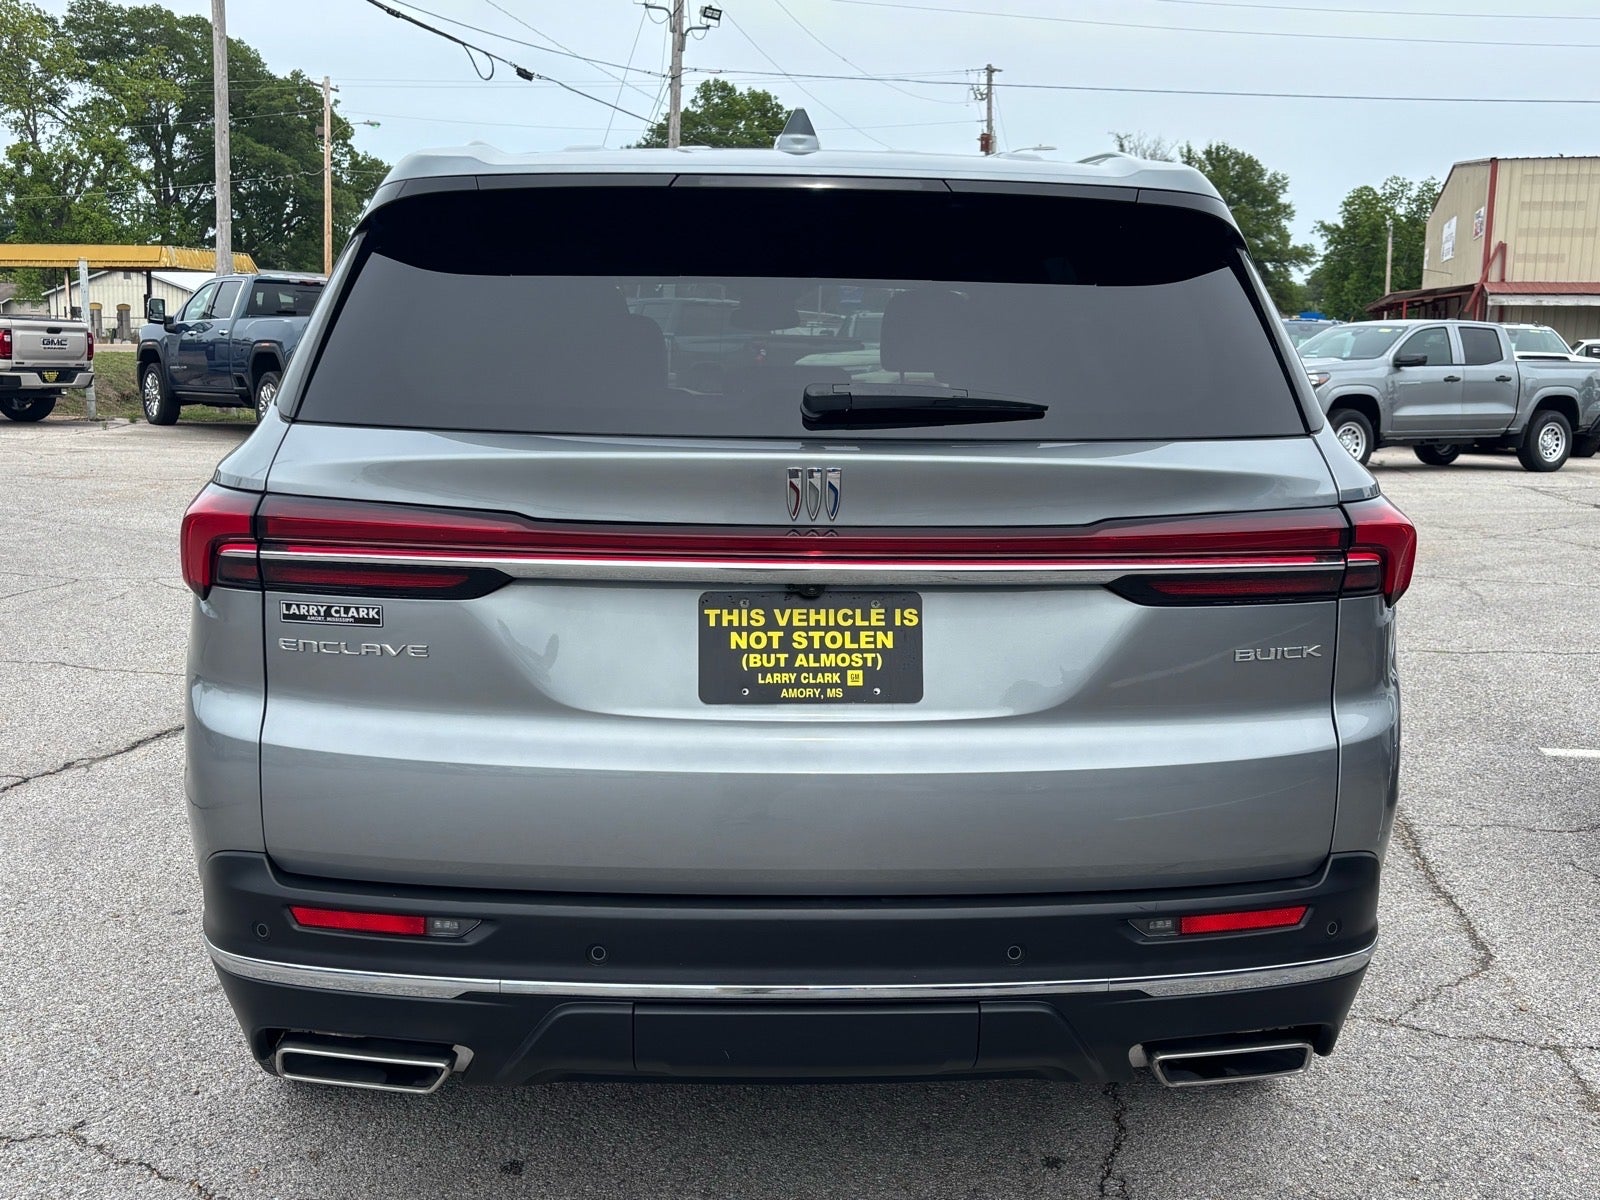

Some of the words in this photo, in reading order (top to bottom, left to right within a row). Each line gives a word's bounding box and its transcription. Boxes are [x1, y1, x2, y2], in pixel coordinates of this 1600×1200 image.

[42, 338, 68, 346] GMC
[282, 604, 327, 616] LARRY
[331, 607, 380, 618] CLARK
[704, 608, 766, 627] THIS
[773, 608, 886, 627] VEHICLE
[894, 608, 919, 627] IS
[278, 637, 429, 658] ENCLAVE
[730, 631, 784, 649] NOT
[791, 631, 894, 649] STOLEN
[1235, 644, 1322, 661] BUICK
[741, 653, 788, 670] (BUT
[794, 653, 883, 670] ALMOST)
[758, 672, 798, 684] LARRY
[800, 672, 841, 684] CLARK
[780, 687, 824, 700] AMORY,
[826, 687, 844, 699] MS
